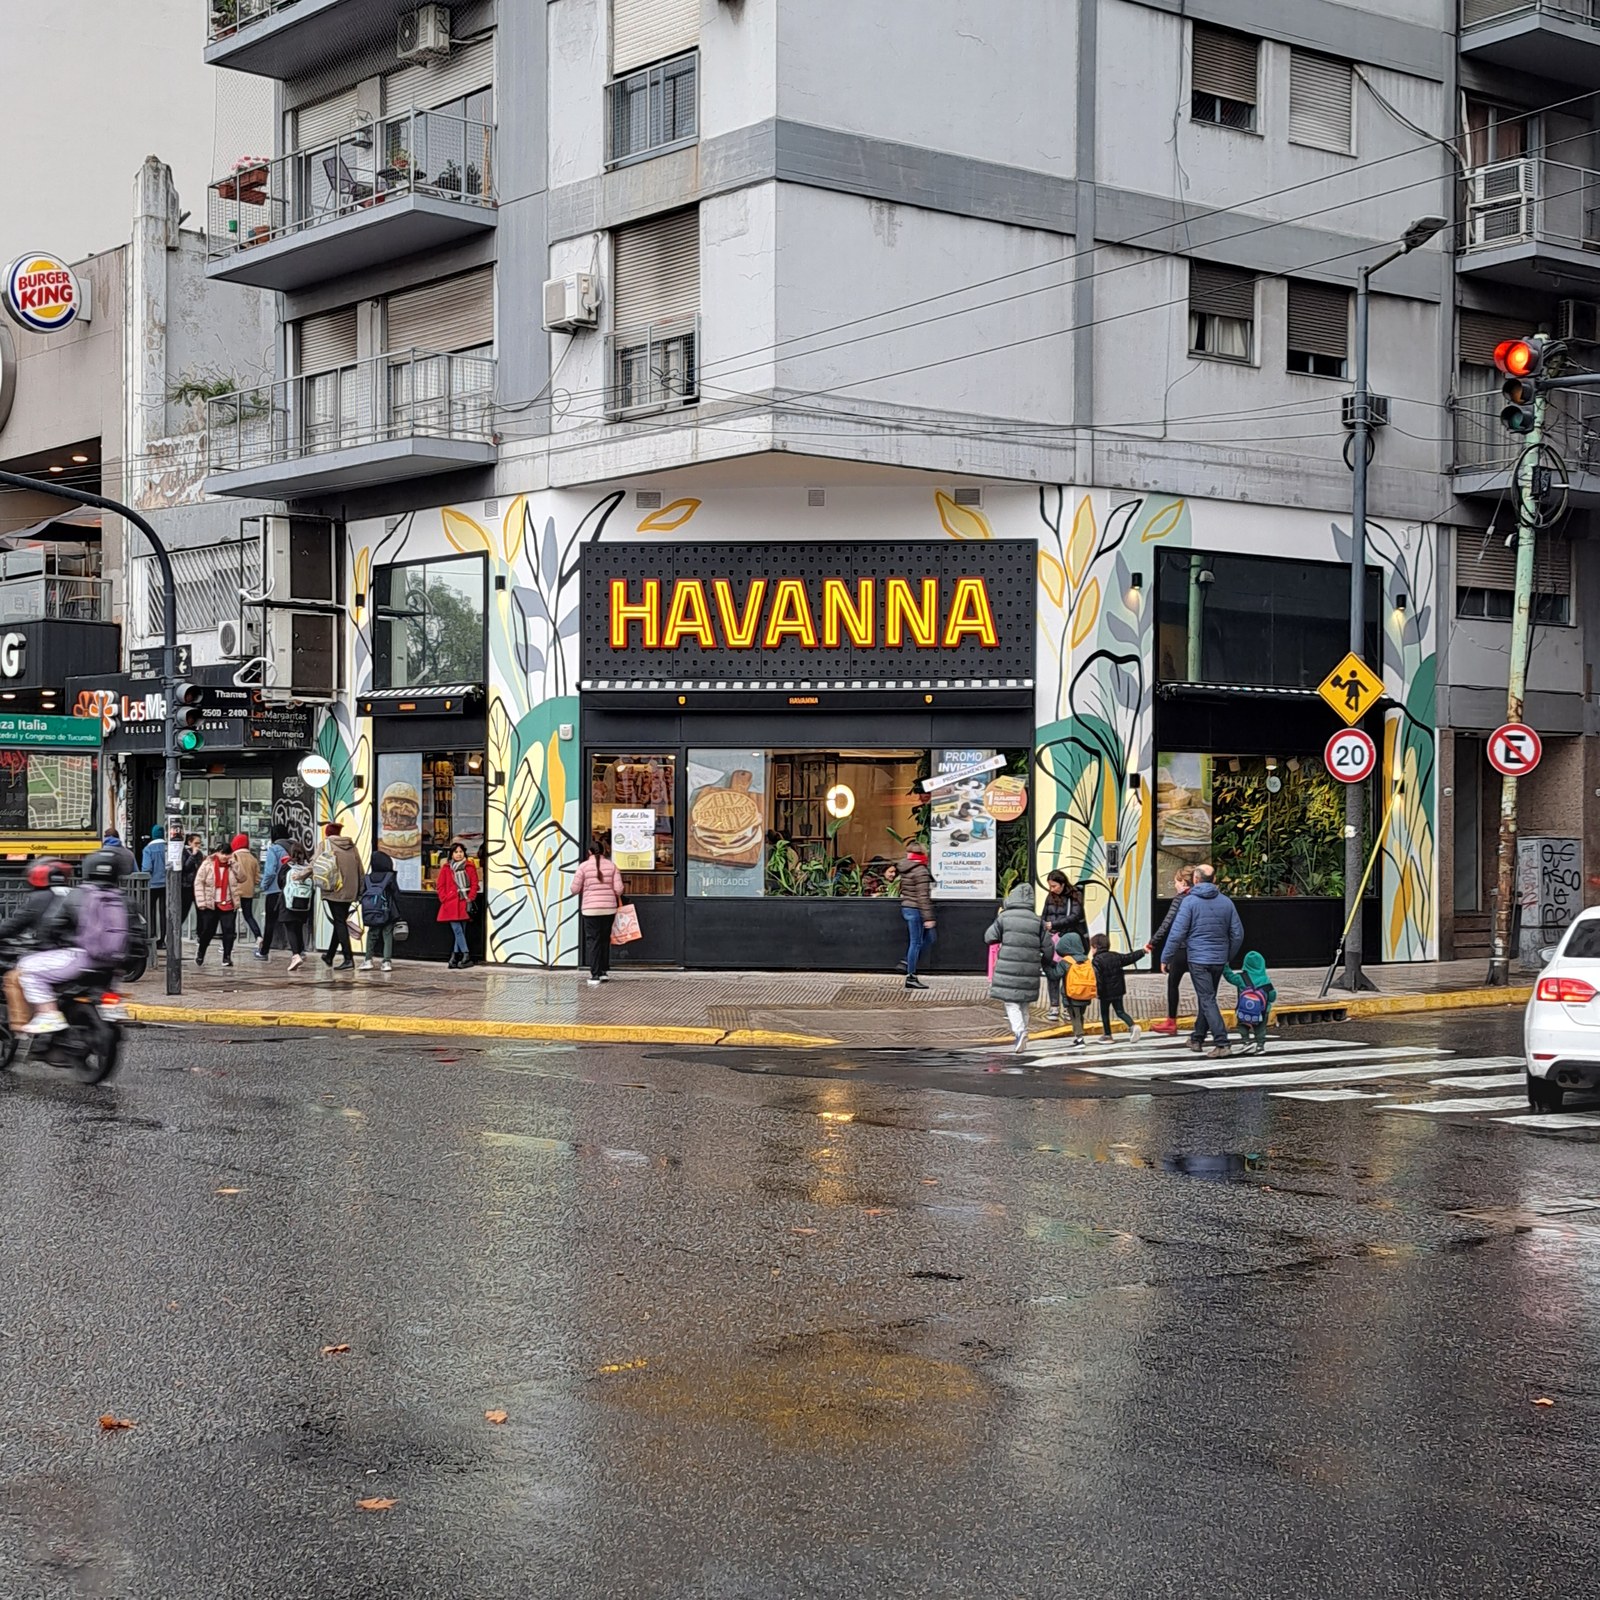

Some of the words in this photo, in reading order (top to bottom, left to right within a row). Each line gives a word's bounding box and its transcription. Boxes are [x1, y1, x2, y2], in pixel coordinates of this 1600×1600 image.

[18, 271, 70, 291] BURGER
[21, 285, 73, 310] KING
[609, 577, 1000, 649] HAVANNA
[215, 690, 247, 698] Thames
[122, 693, 167, 721] LasMa
[228, 709, 248, 717] 2400
[18, 719, 47, 731] Italia
[125, 725, 162, 734] BELLEZA
[25, 732, 56, 741] Congreso
[945, 751, 983, 762] PROMO
[1336, 745, 1365, 766] 20
[1504, 735, 1527, 764] E
[986, 790, 995, 806] 1
[991, 805, 1023, 814] REGALO
